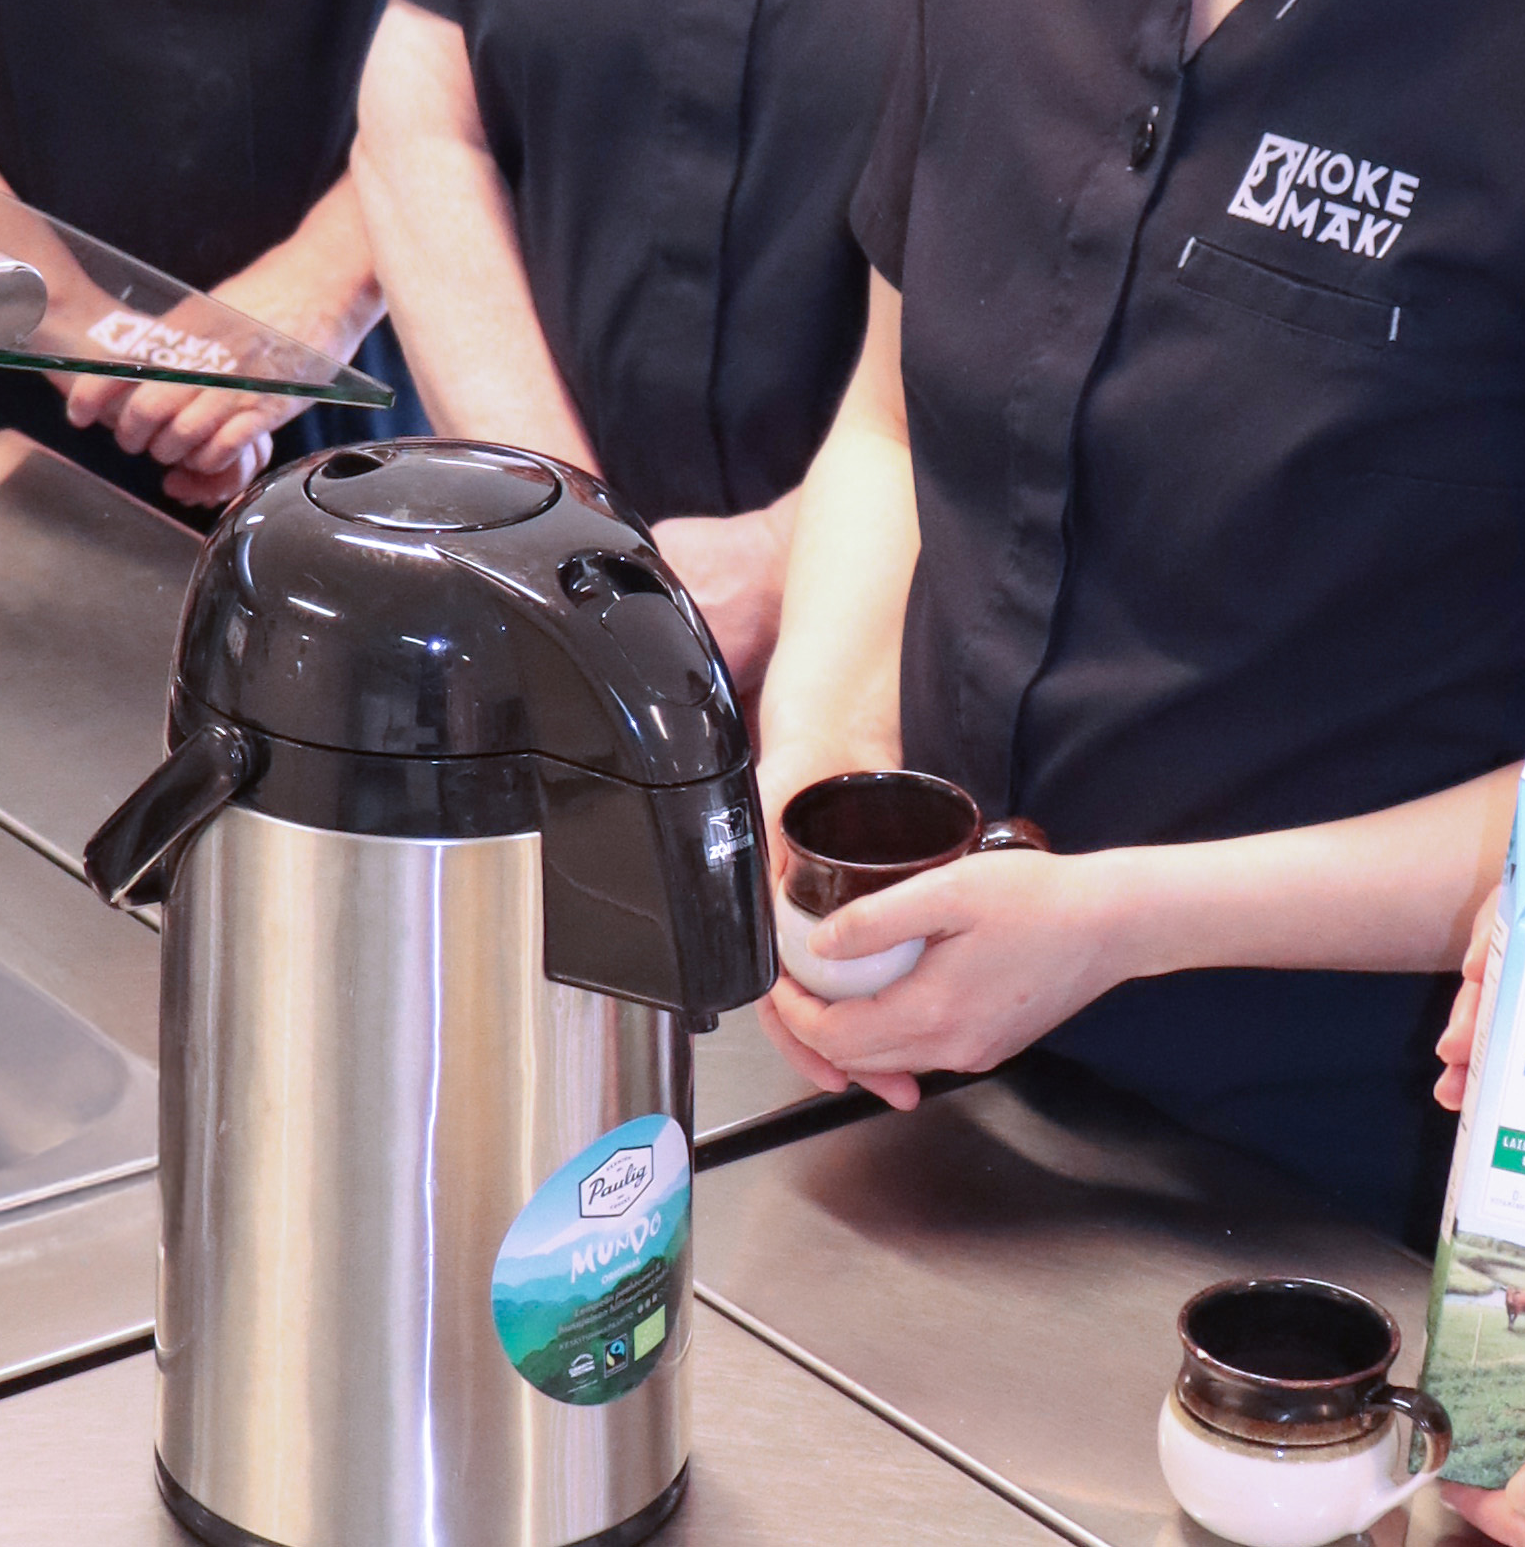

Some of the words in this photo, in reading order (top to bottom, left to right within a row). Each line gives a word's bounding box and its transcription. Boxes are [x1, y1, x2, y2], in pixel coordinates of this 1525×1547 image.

[1296, 146, 1420, 218] KOKE
[588, 1163, 647, 1205] Paulig
[571, 1211, 661, 1284] MUNDO
